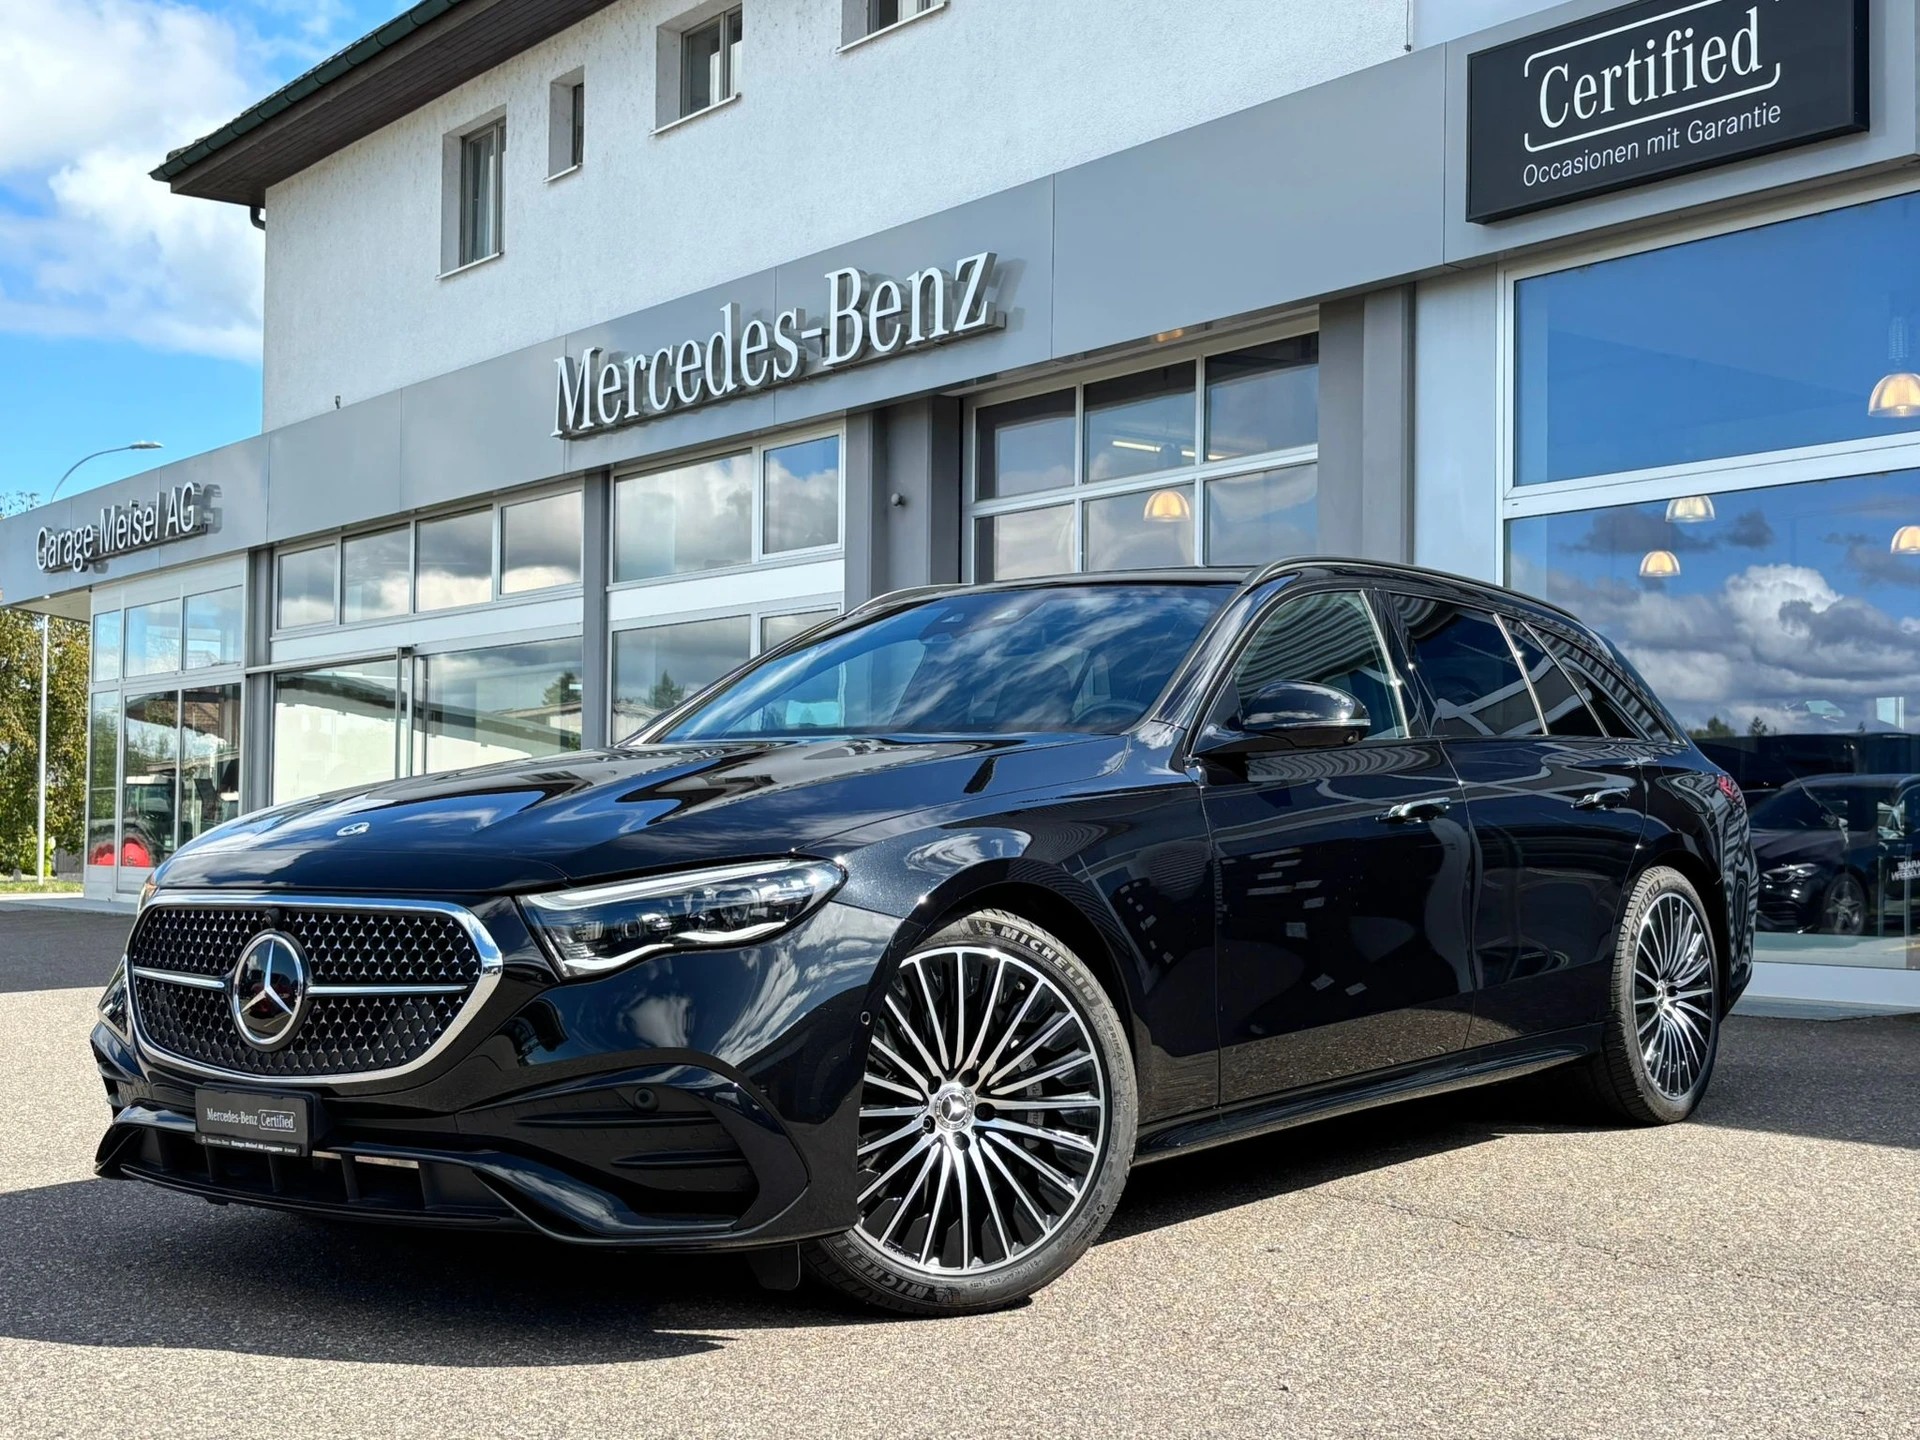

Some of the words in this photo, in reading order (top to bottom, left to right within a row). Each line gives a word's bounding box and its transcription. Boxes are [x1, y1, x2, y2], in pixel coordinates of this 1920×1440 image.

[1539, 6, 1763, 129] Certified
[1523, 141, 1639, 187] Occasionen
[1646, 128, 1680, 156] mit
[1687, 102, 1782, 145] Garantie
[550, 251, 998, 438] Mercedes-Benz
[36, 523, 94, 573] Garage
[100, 491, 161, 553] Meisel
[165, 481, 196, 538] AG
[1000, 925, 1097, 1001] MICHELIN
[206, 1107, 258, 1126] Mercedes-Benz
[261, 1112, 294, 1129] Certified
